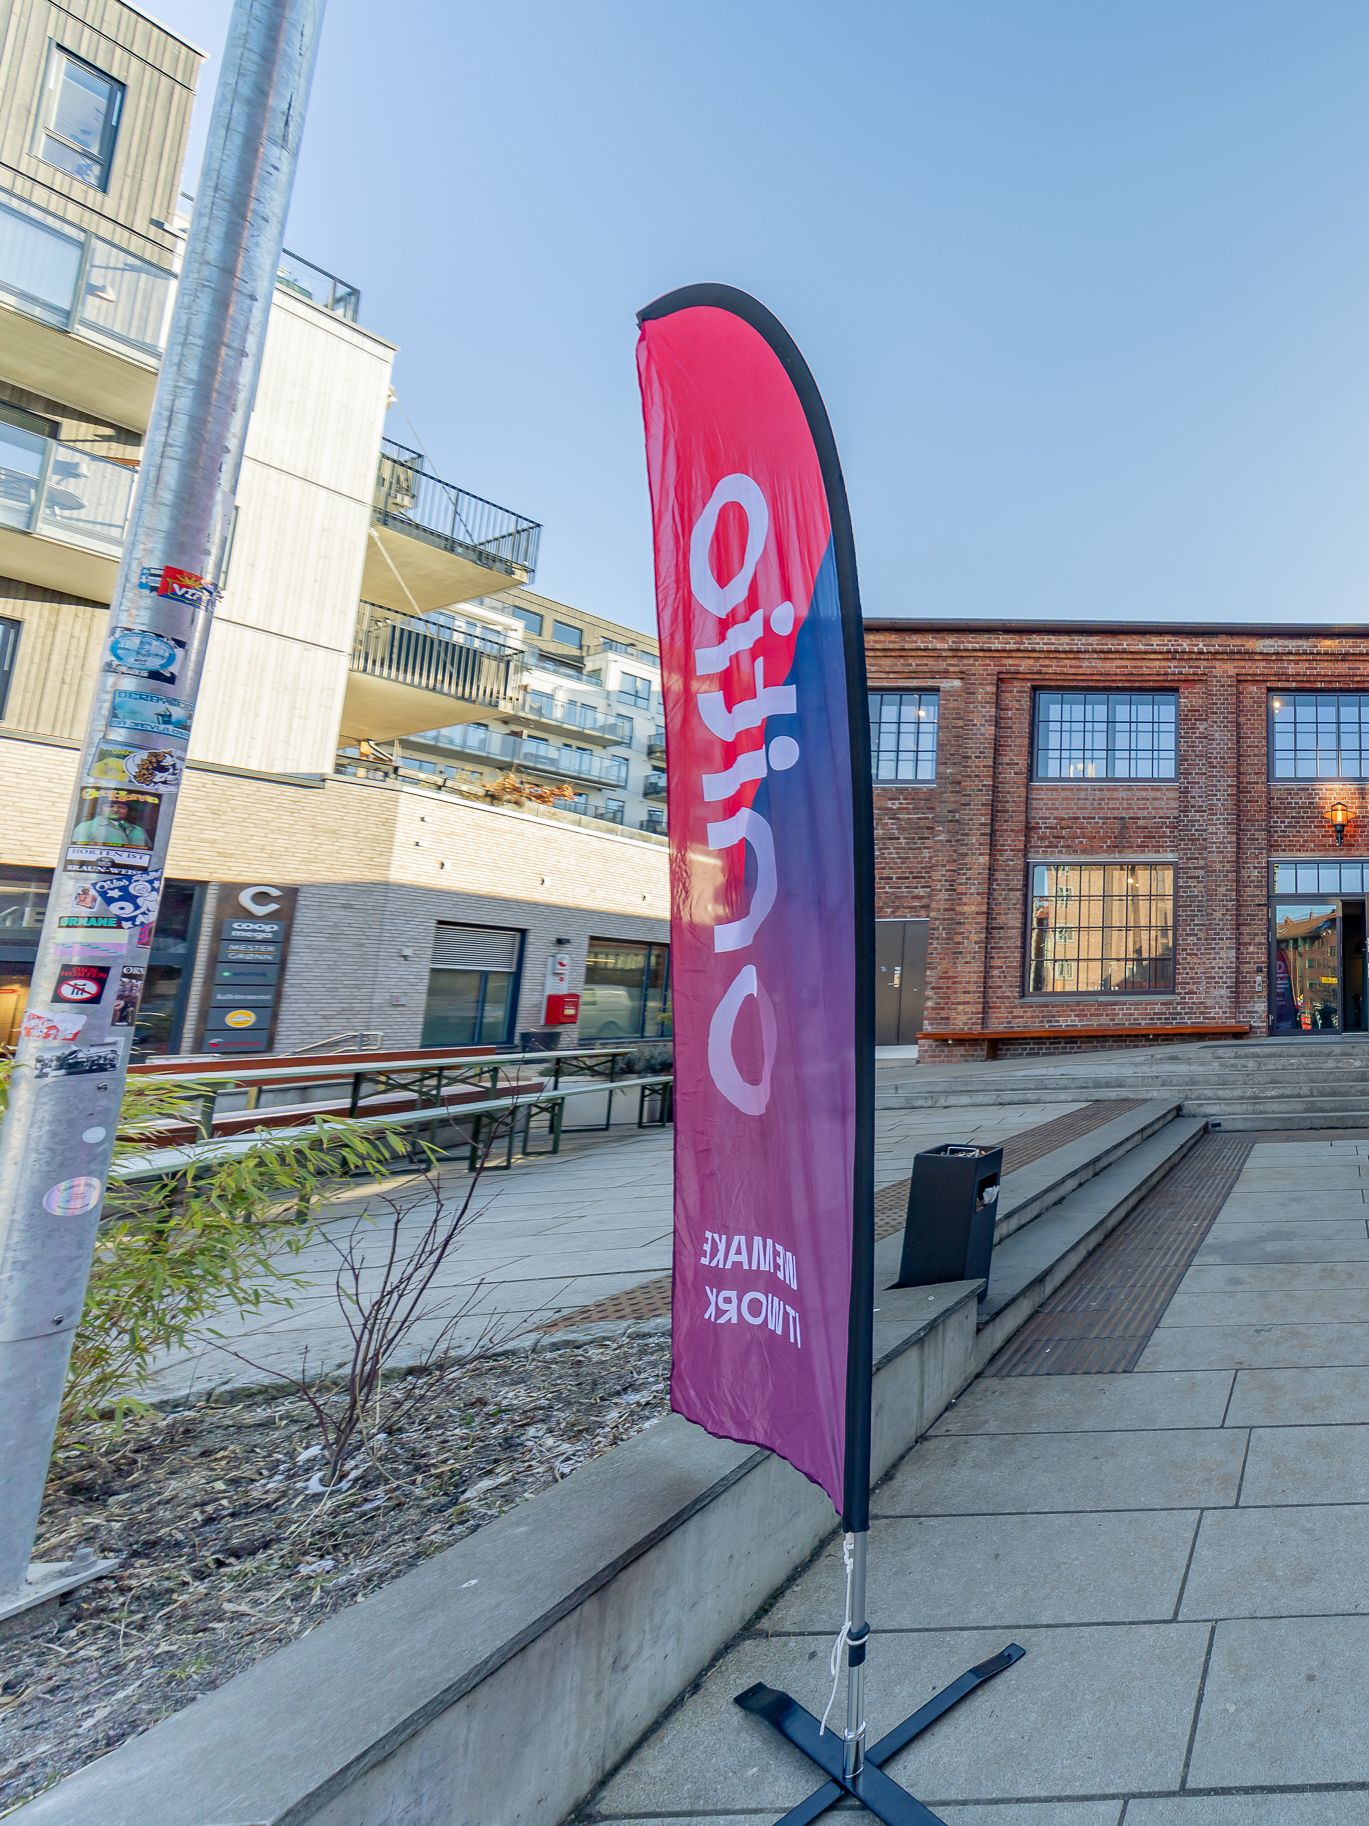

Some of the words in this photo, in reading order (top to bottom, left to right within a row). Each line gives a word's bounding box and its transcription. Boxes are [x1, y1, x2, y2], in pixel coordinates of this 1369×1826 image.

[72, 848, 122, 858] HORTEN
[127, 852, 143, 860] IST
[232, 922, 279, 932] coop
[231, 931, 273, 940] mega
[228, 944, 275, 952] MESTER
